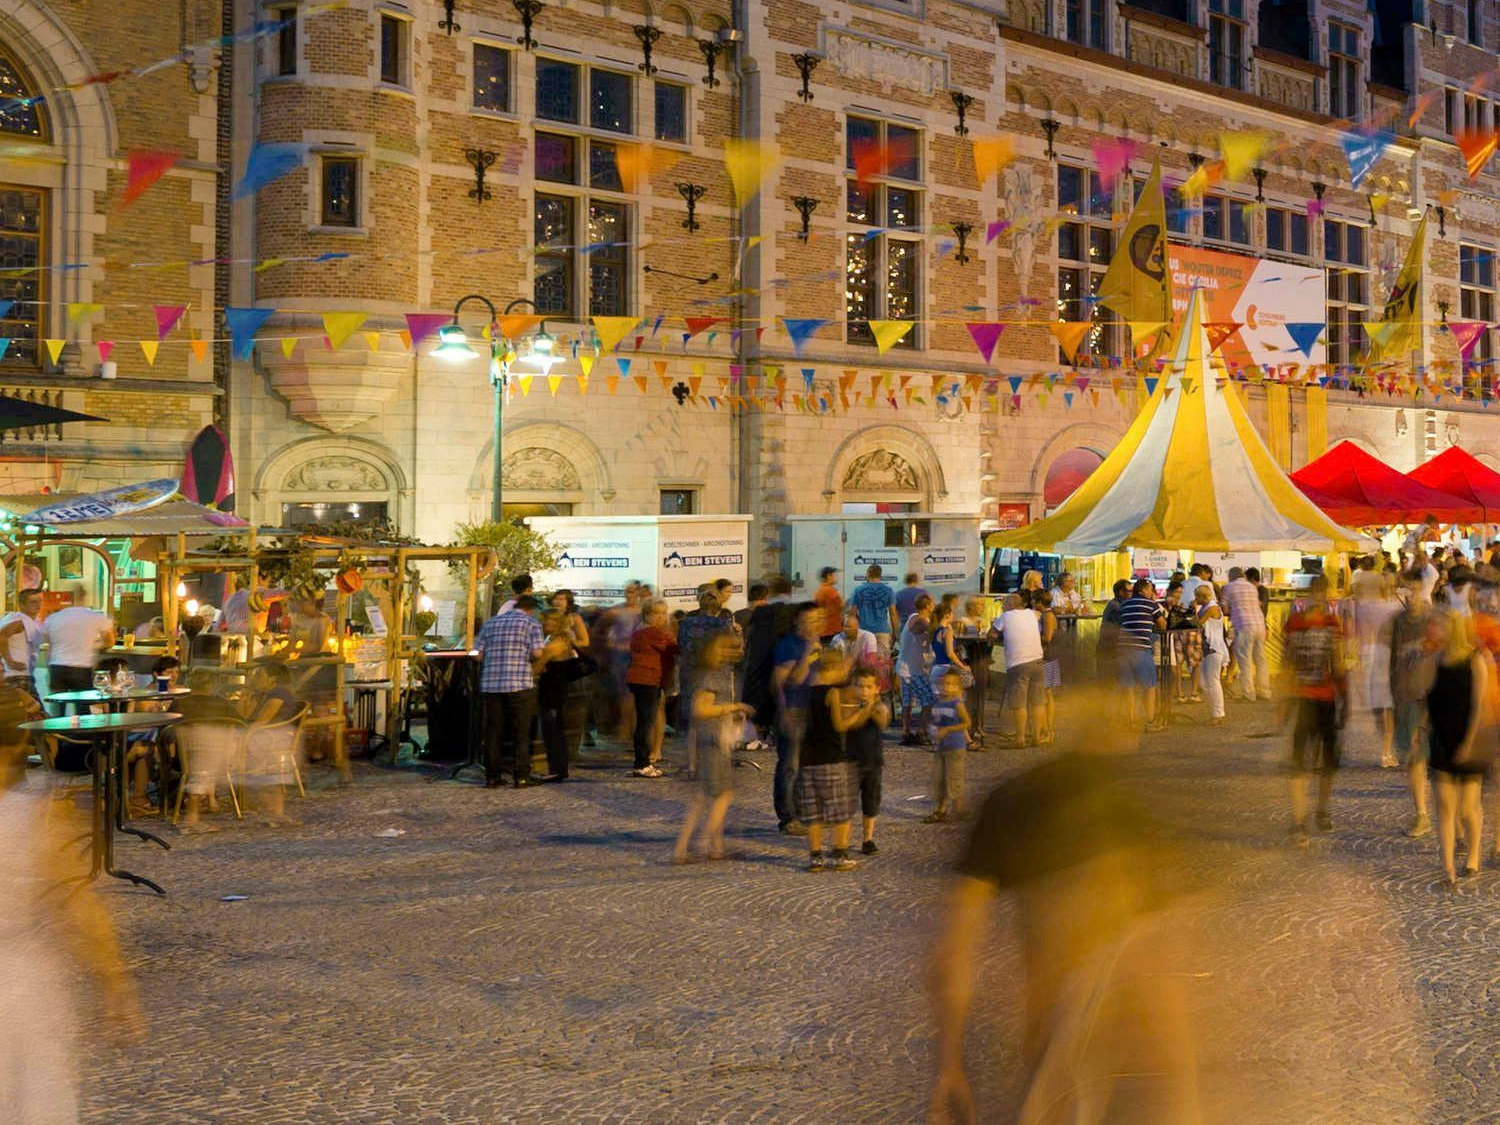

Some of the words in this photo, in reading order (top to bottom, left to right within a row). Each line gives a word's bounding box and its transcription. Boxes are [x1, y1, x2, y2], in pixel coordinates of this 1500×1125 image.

[573, 558, 590, 567] BEN
[591, 558, 628, 567] STEVENS
[685, 556, 703, 566] BEN
[704, 555, 742, 565] STEVENS
